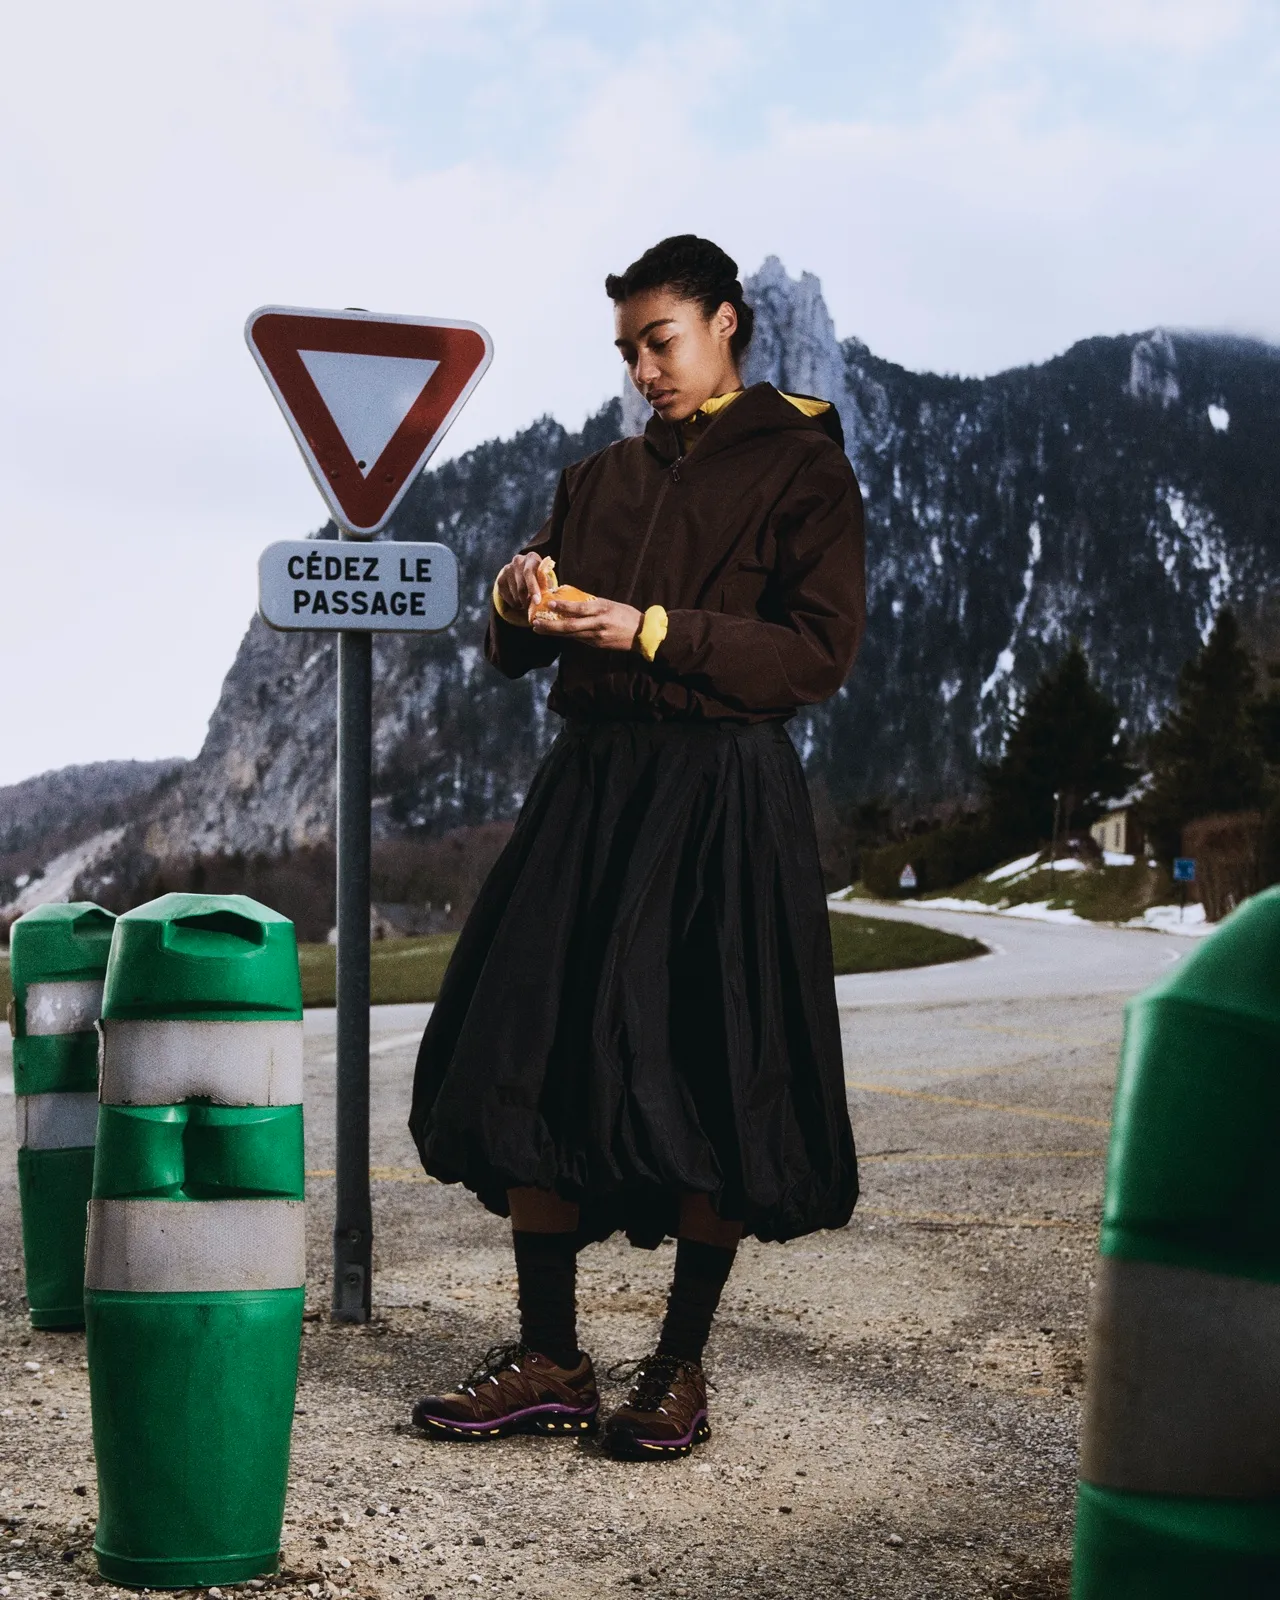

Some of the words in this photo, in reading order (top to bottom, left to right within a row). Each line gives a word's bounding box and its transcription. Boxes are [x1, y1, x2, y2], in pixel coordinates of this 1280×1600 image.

[287, 550, 380, 582] CÉDEZ
[399, 557, 432, 583] LE
[293, 589, 427, 617] PASSAGE
